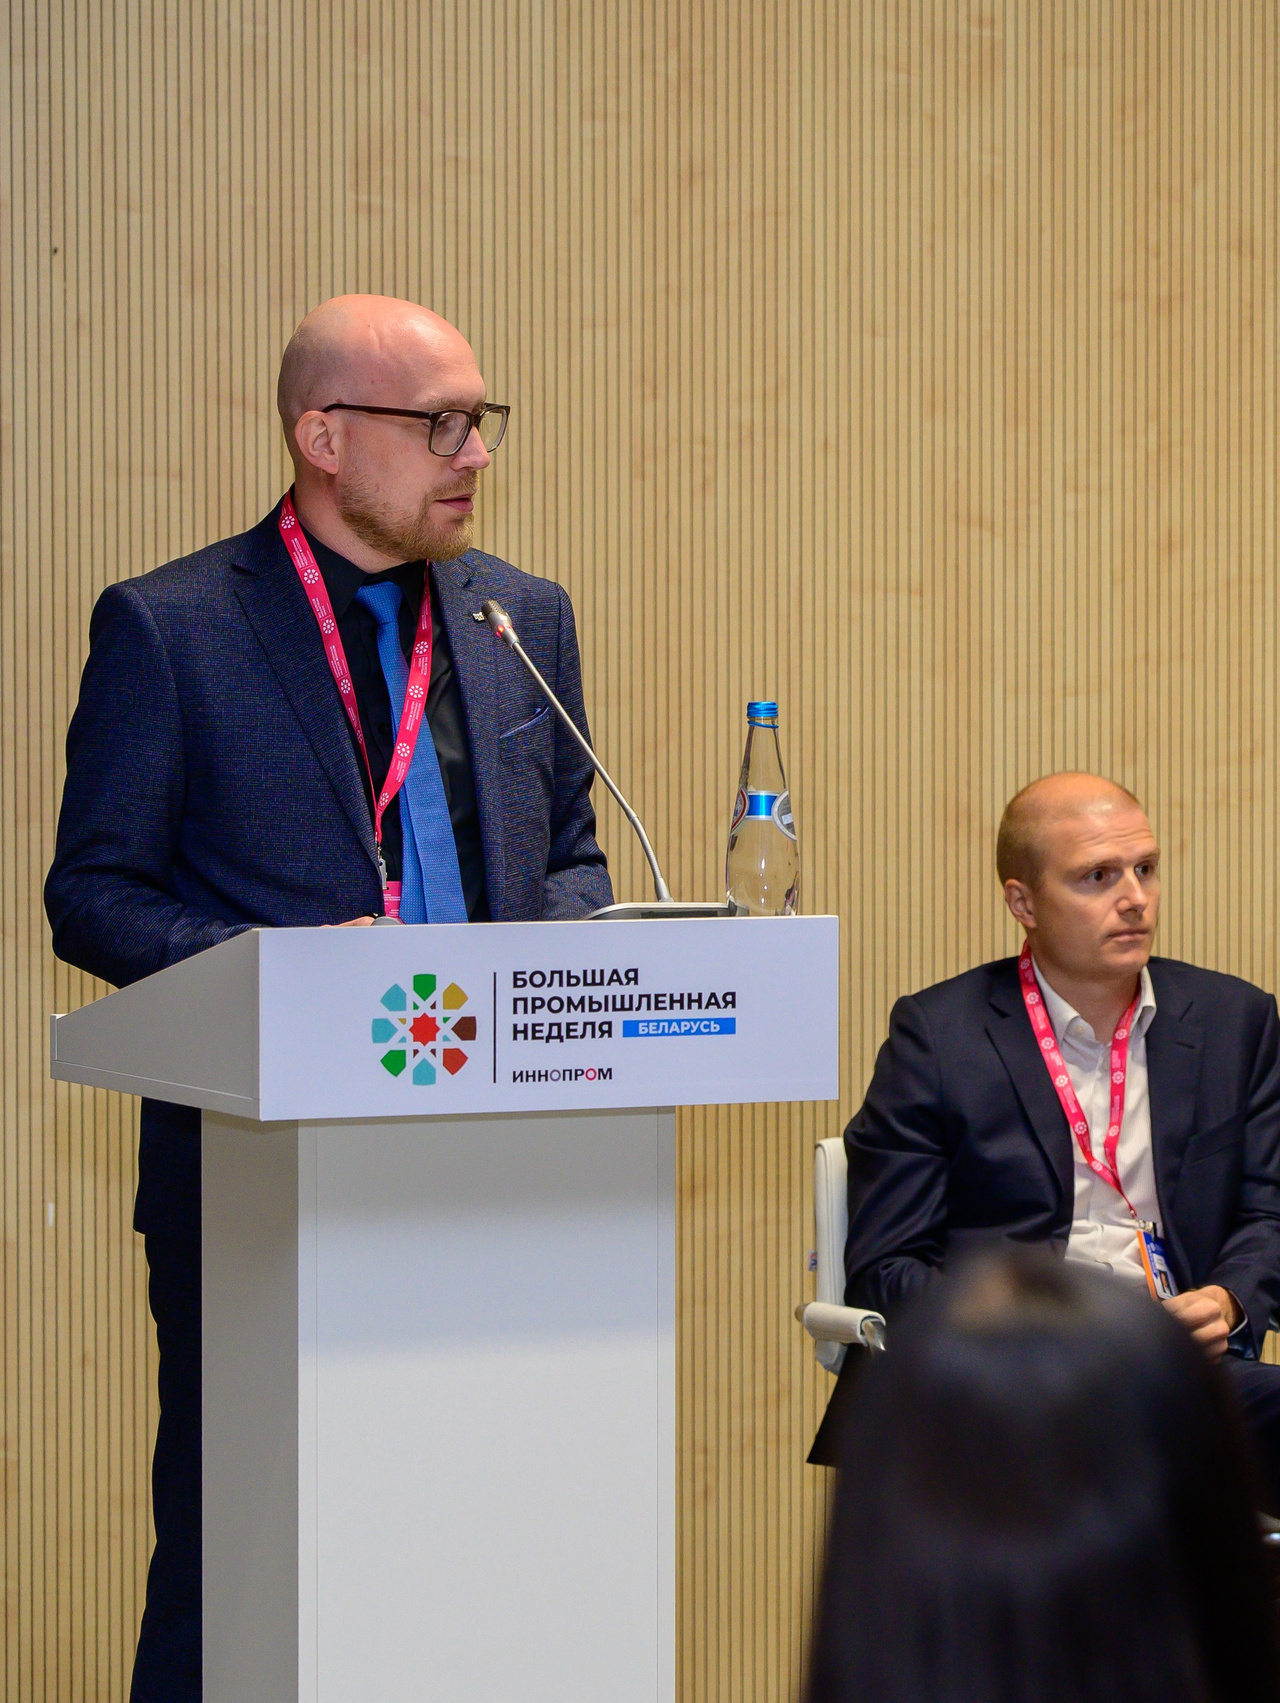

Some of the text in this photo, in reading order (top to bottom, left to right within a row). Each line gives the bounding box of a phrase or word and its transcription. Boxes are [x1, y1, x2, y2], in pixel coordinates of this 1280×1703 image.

[512, 967, 640, 989] БОЛЬШАЯ
[512, 991, 737, 1015] ПРОМЫШЛЕННАЯ
[512, 1020, 721, 1043] НЕДЕЛЯ БЕЛАРУСЬ
[512, 1067, 613, 1083] ИННОПРОМ
